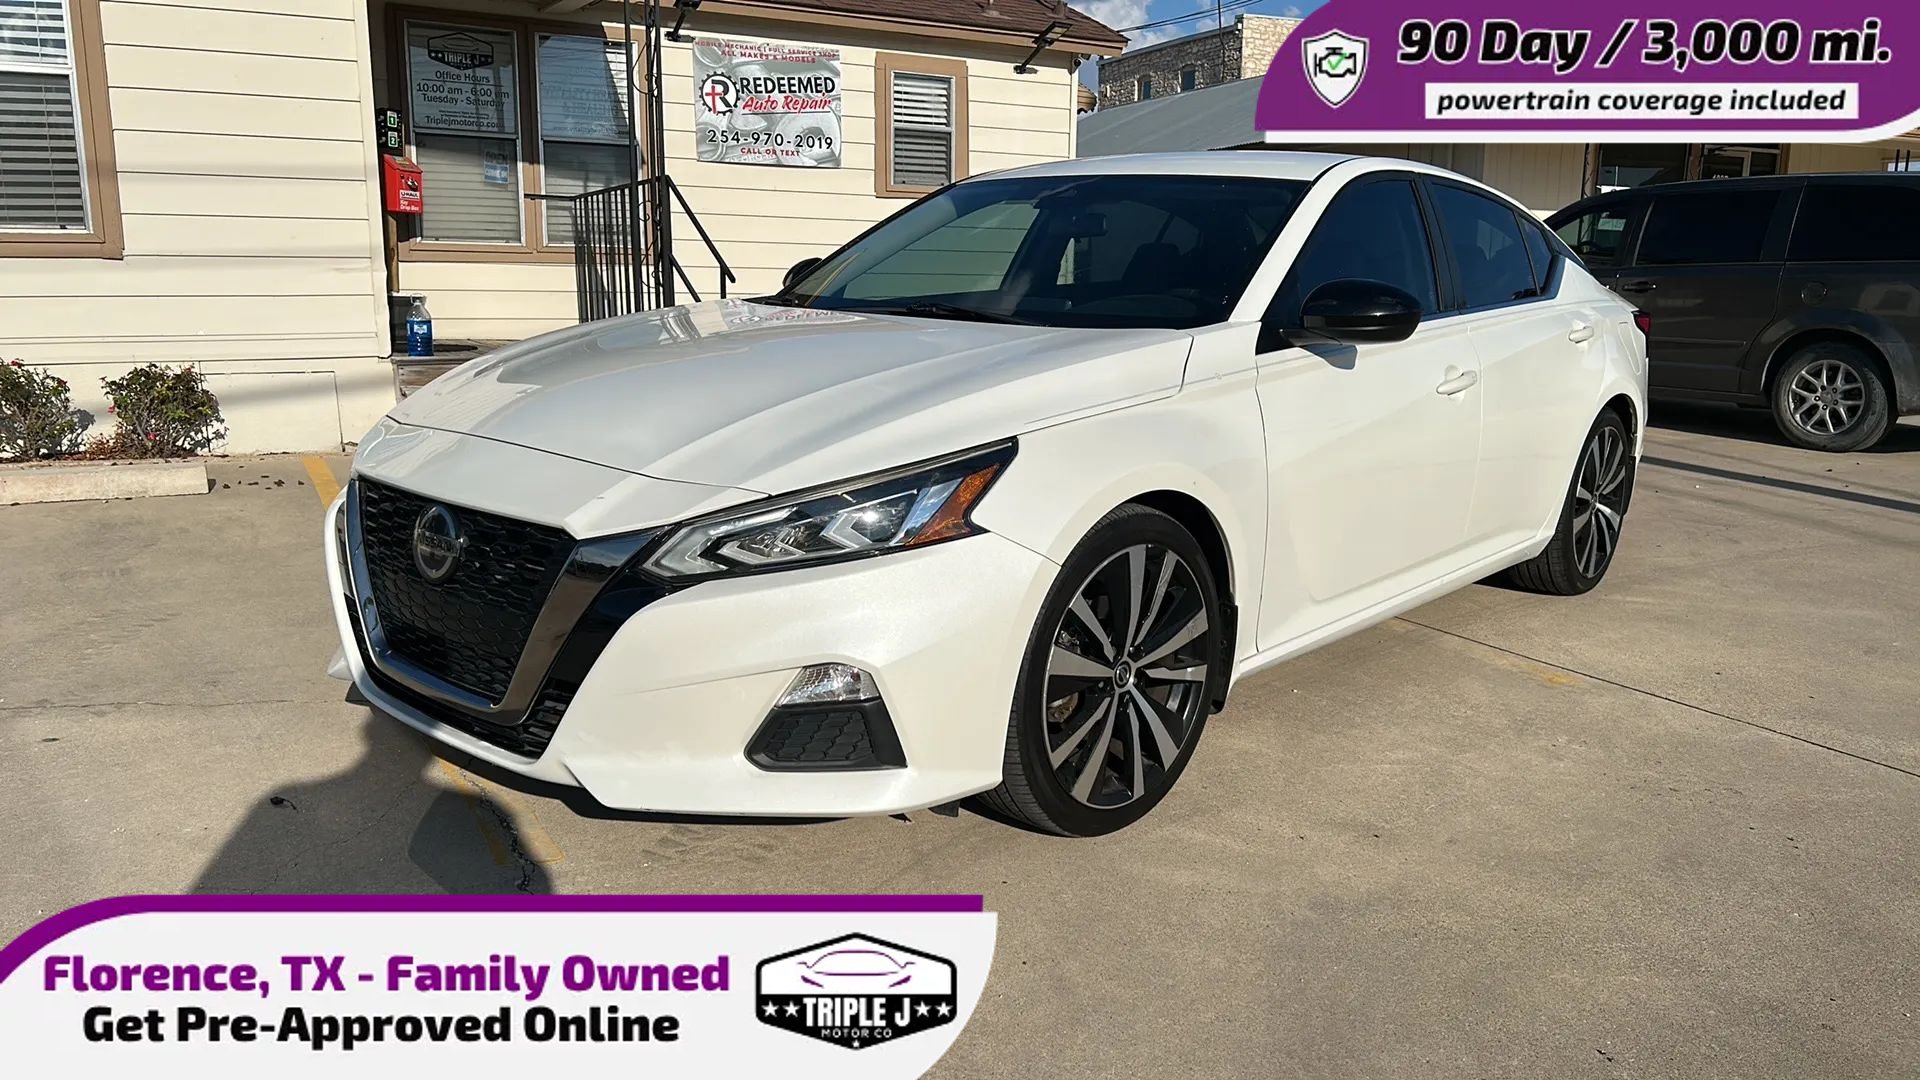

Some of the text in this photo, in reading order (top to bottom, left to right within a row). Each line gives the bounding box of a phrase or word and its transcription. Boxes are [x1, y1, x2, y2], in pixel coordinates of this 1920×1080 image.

[720, 49, 737, 57] ALL
[740, 51, 770, 61] MAKES
[781, 55, 817, 64] MODELS
[724, 43, 761, 52] MECHANIC
[768, 47, 786, 55] FULL
[788, 49, 820, 57] SERVICE
[435, 70, 490, 83] Office Hours
[416, 82, 445, 93] 10:00
[447, 86, 463, 95] am
[470, 87, 492, 97] 6:00
[739, 77, 836, 95] REDEEMED
[421, 93, 459, 105] Tuesday
[742, 92, 832, 114] Auto Repair
[706, 129, 833, 150] 254-970-2019
[740, 147, 762, 155] CALL
[765, 148, 778, 156] OR
